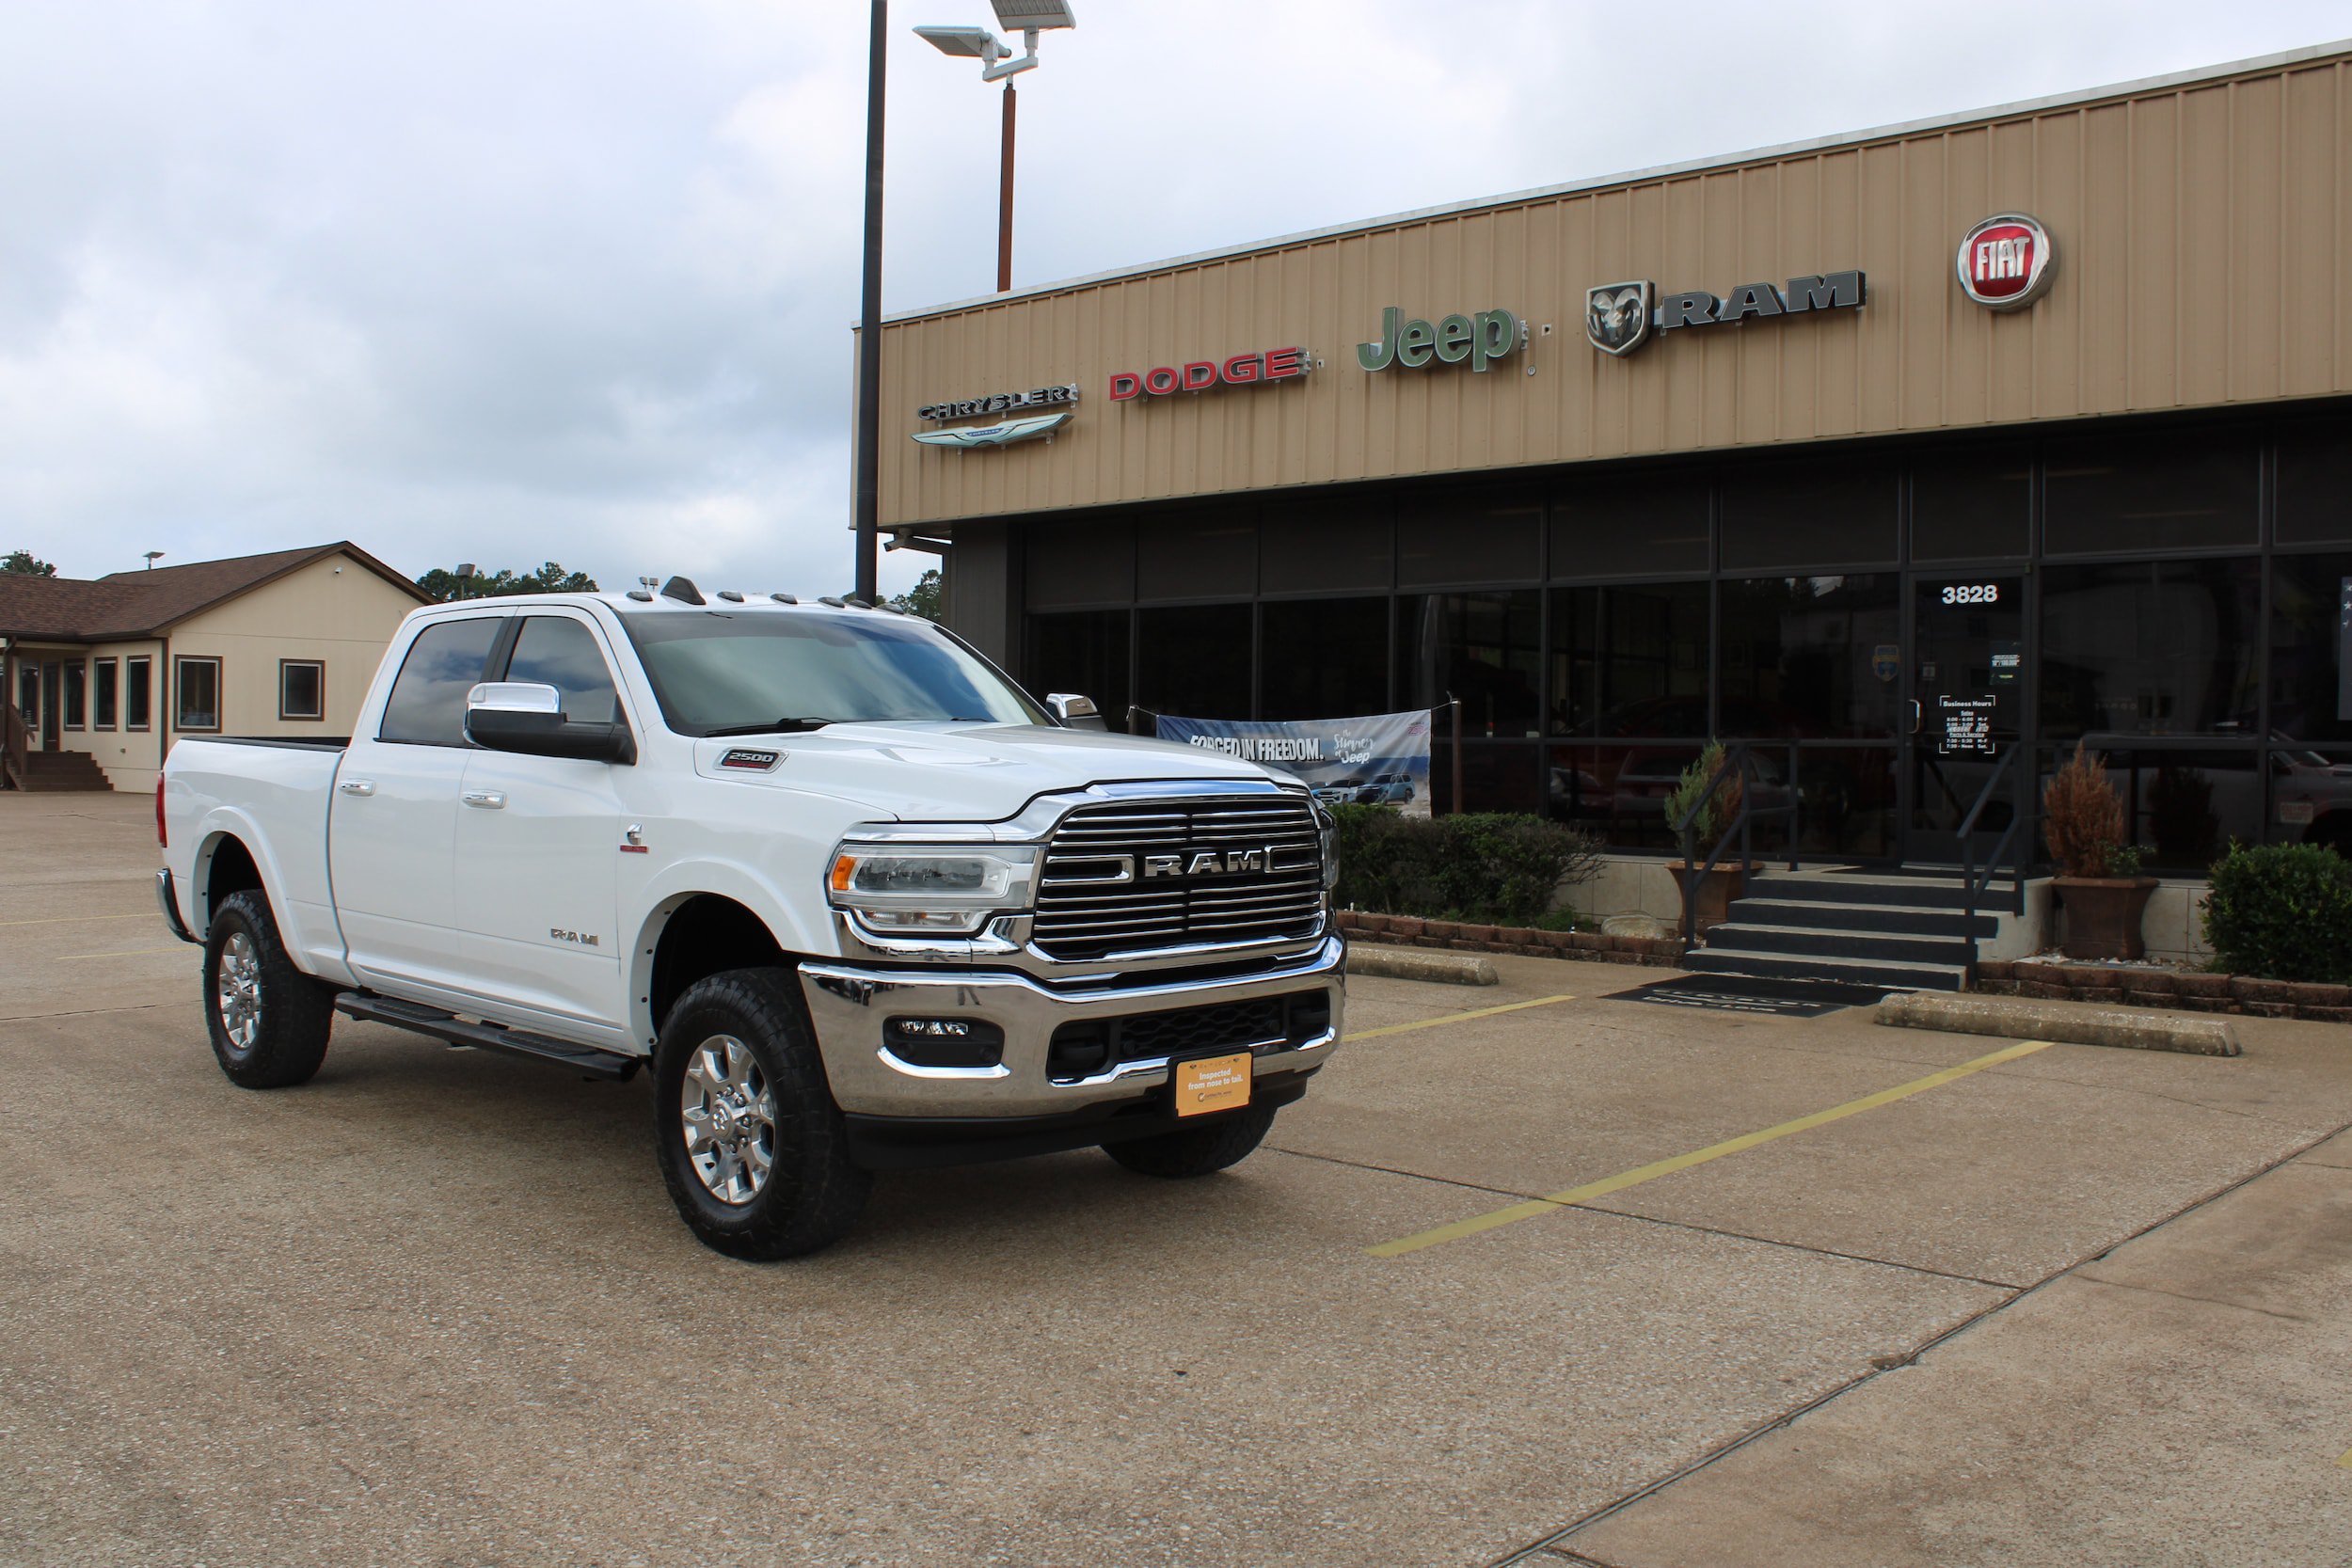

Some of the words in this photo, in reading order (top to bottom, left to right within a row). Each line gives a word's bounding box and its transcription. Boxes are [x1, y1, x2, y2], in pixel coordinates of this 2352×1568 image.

[1976, 236, 2030, 282] FIAT
[1661, 270, 1862, 329] RAM
[1356, 307, 1517, 372] Jeep
[1109, 346, 1301, 402] DODGE
[917, 386, 1073, 420] CHRYSLER
[1942, 584, 1997, 605] 3828
[729, 752, 774, 763] 2500
[1241, 738, 1256, 760] IN
[1258, 738, 1325, 761] FREEDOM.
[1341, 750, 1371, 764] Jeep
[1145, 849, 1263, 878] RAM
[550, 928, 599, 946] RAM
[1188, 1082, 1205, 1090] from
[1232, 1074, 1244, 1084] tail.
[1199, 1068, 1232, 1081] Inspected
